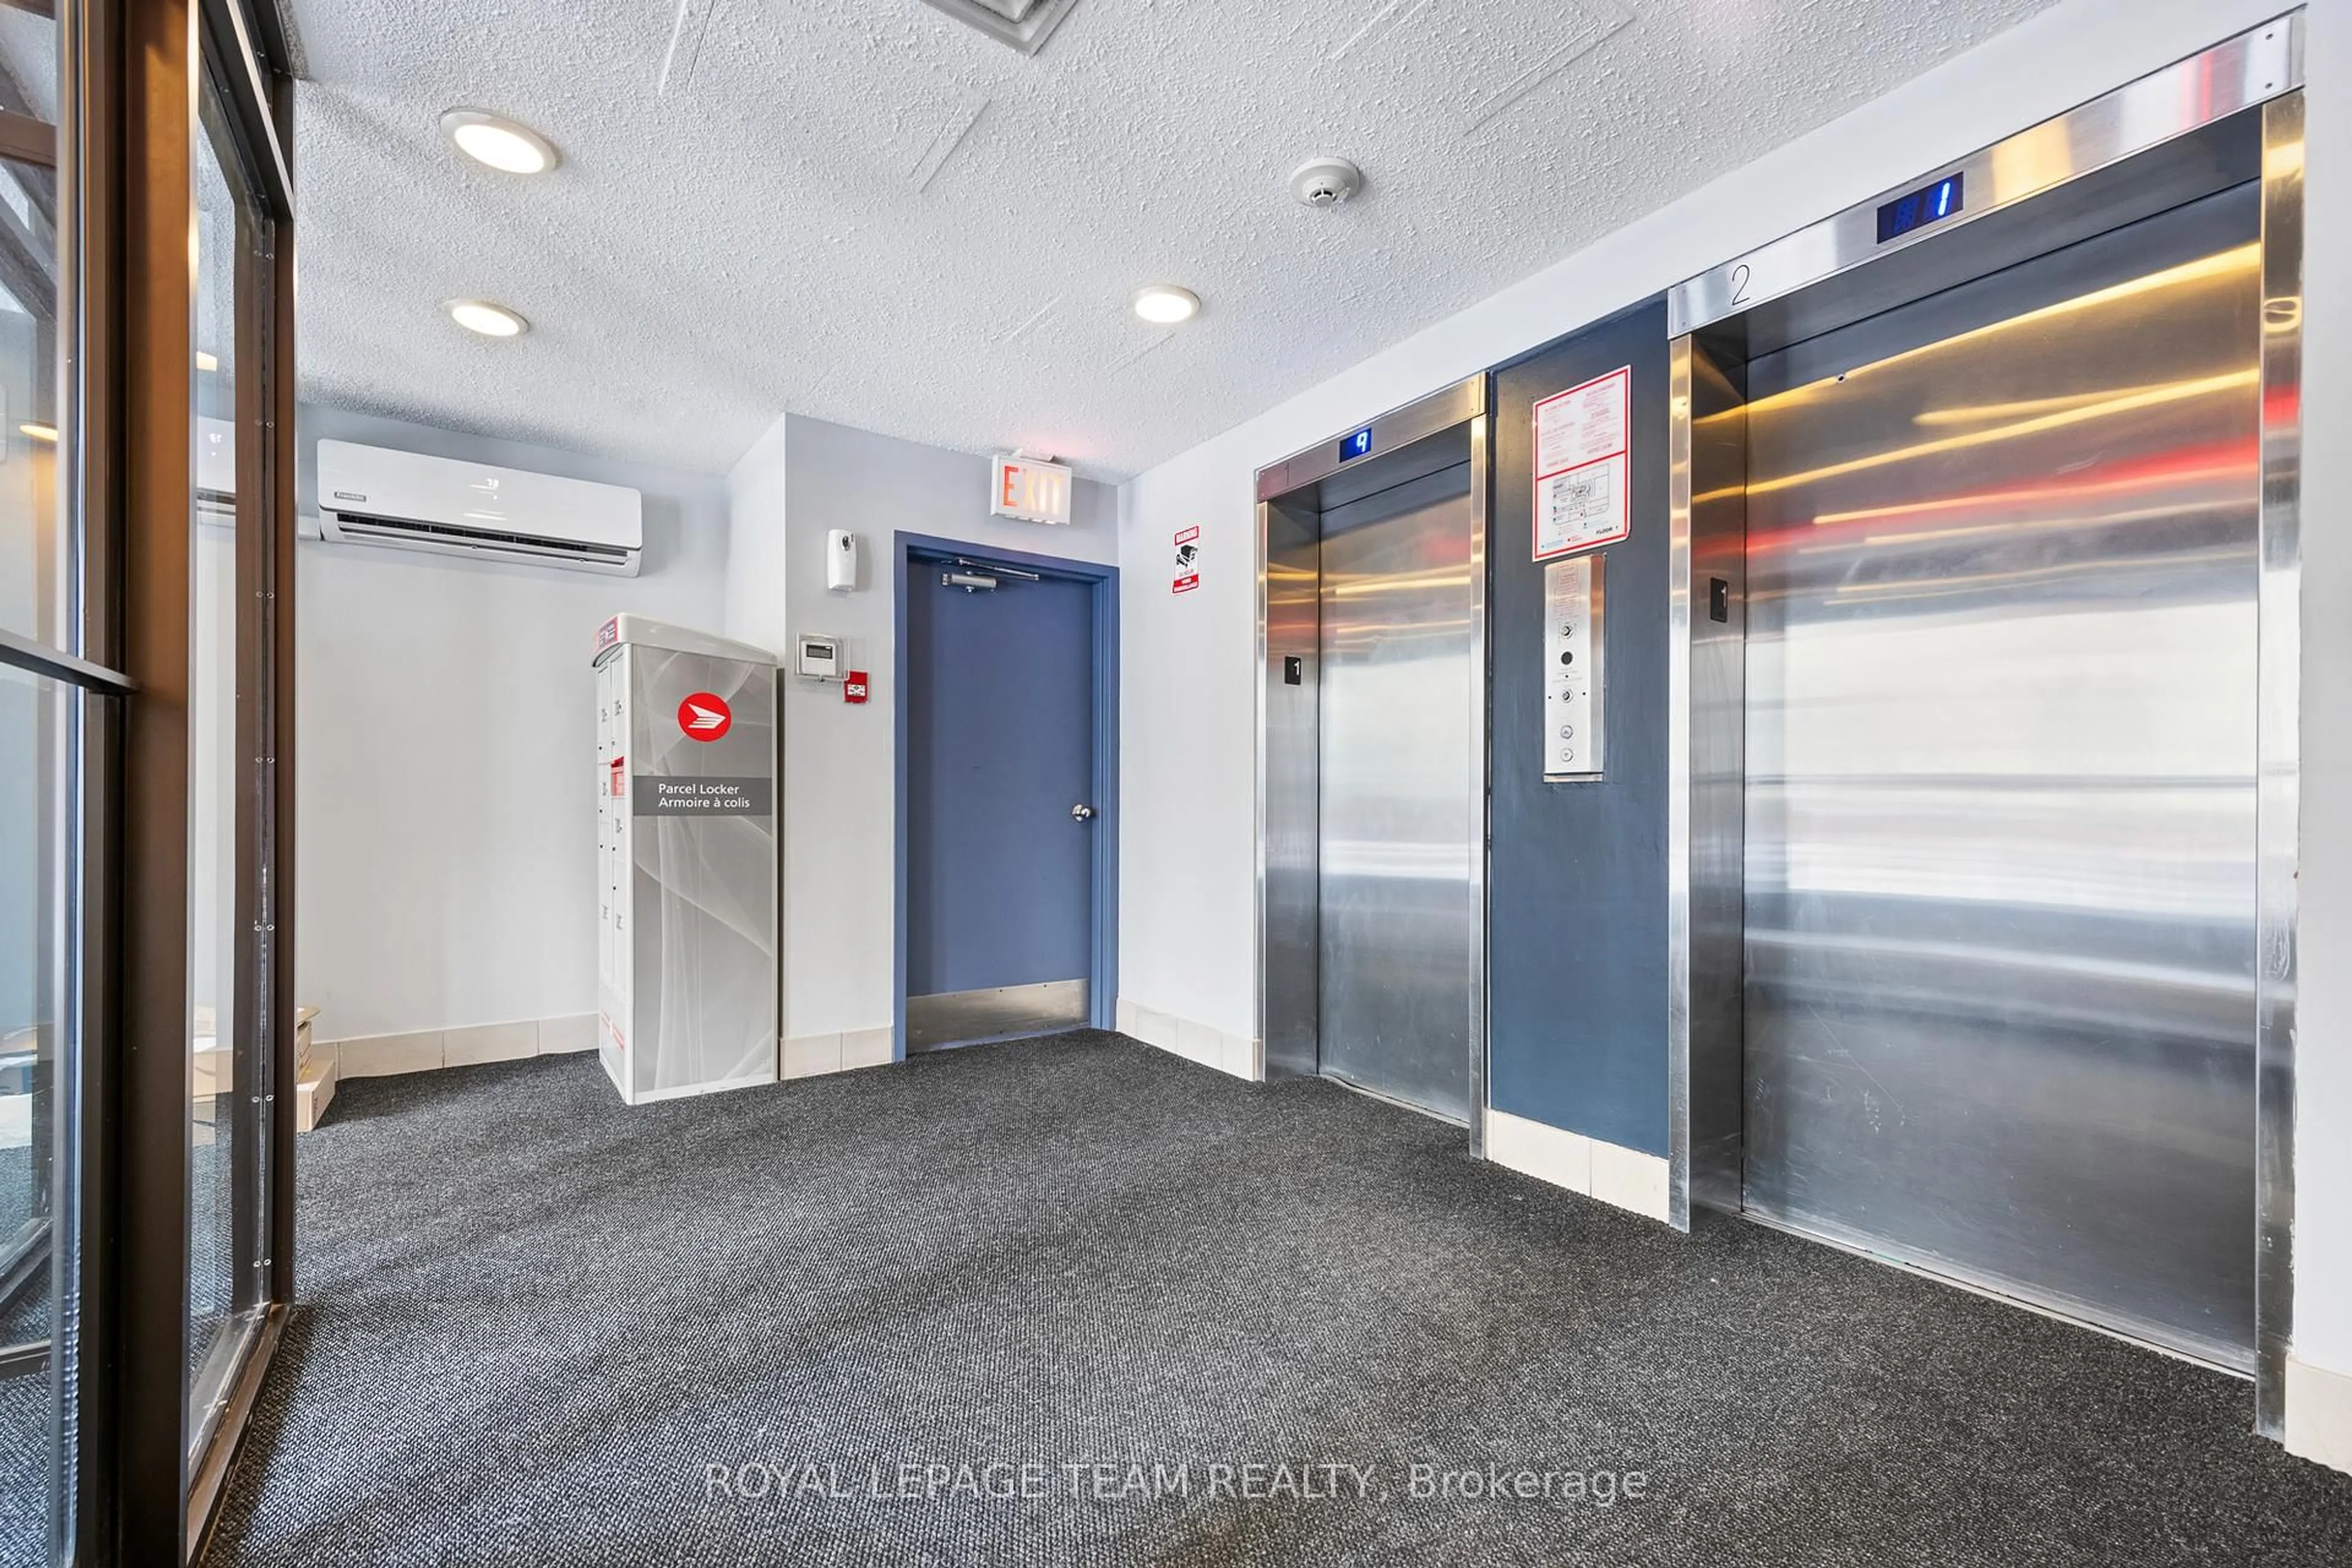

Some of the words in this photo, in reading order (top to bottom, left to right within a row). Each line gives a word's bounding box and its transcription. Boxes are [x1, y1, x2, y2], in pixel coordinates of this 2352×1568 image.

[1937, 182, 1951, 216] 1
[1732, 264, 1751, 306] 2
[1355, 431, 1369, 453] 9
[1284, 462, 1290, 487] 1
[1003, 465, 1064, 516] EXIT
[1721, 585, 1727, 609] 1
[1294, 660, 1300, 676] 1
[658, 783, 696, 794] Parcel
[699, 783, 740, 795] Locker
[658, 797, 710, 808] Armoire
[714, 797, 721, 808] à
[723, 797, 751, 809] colis
